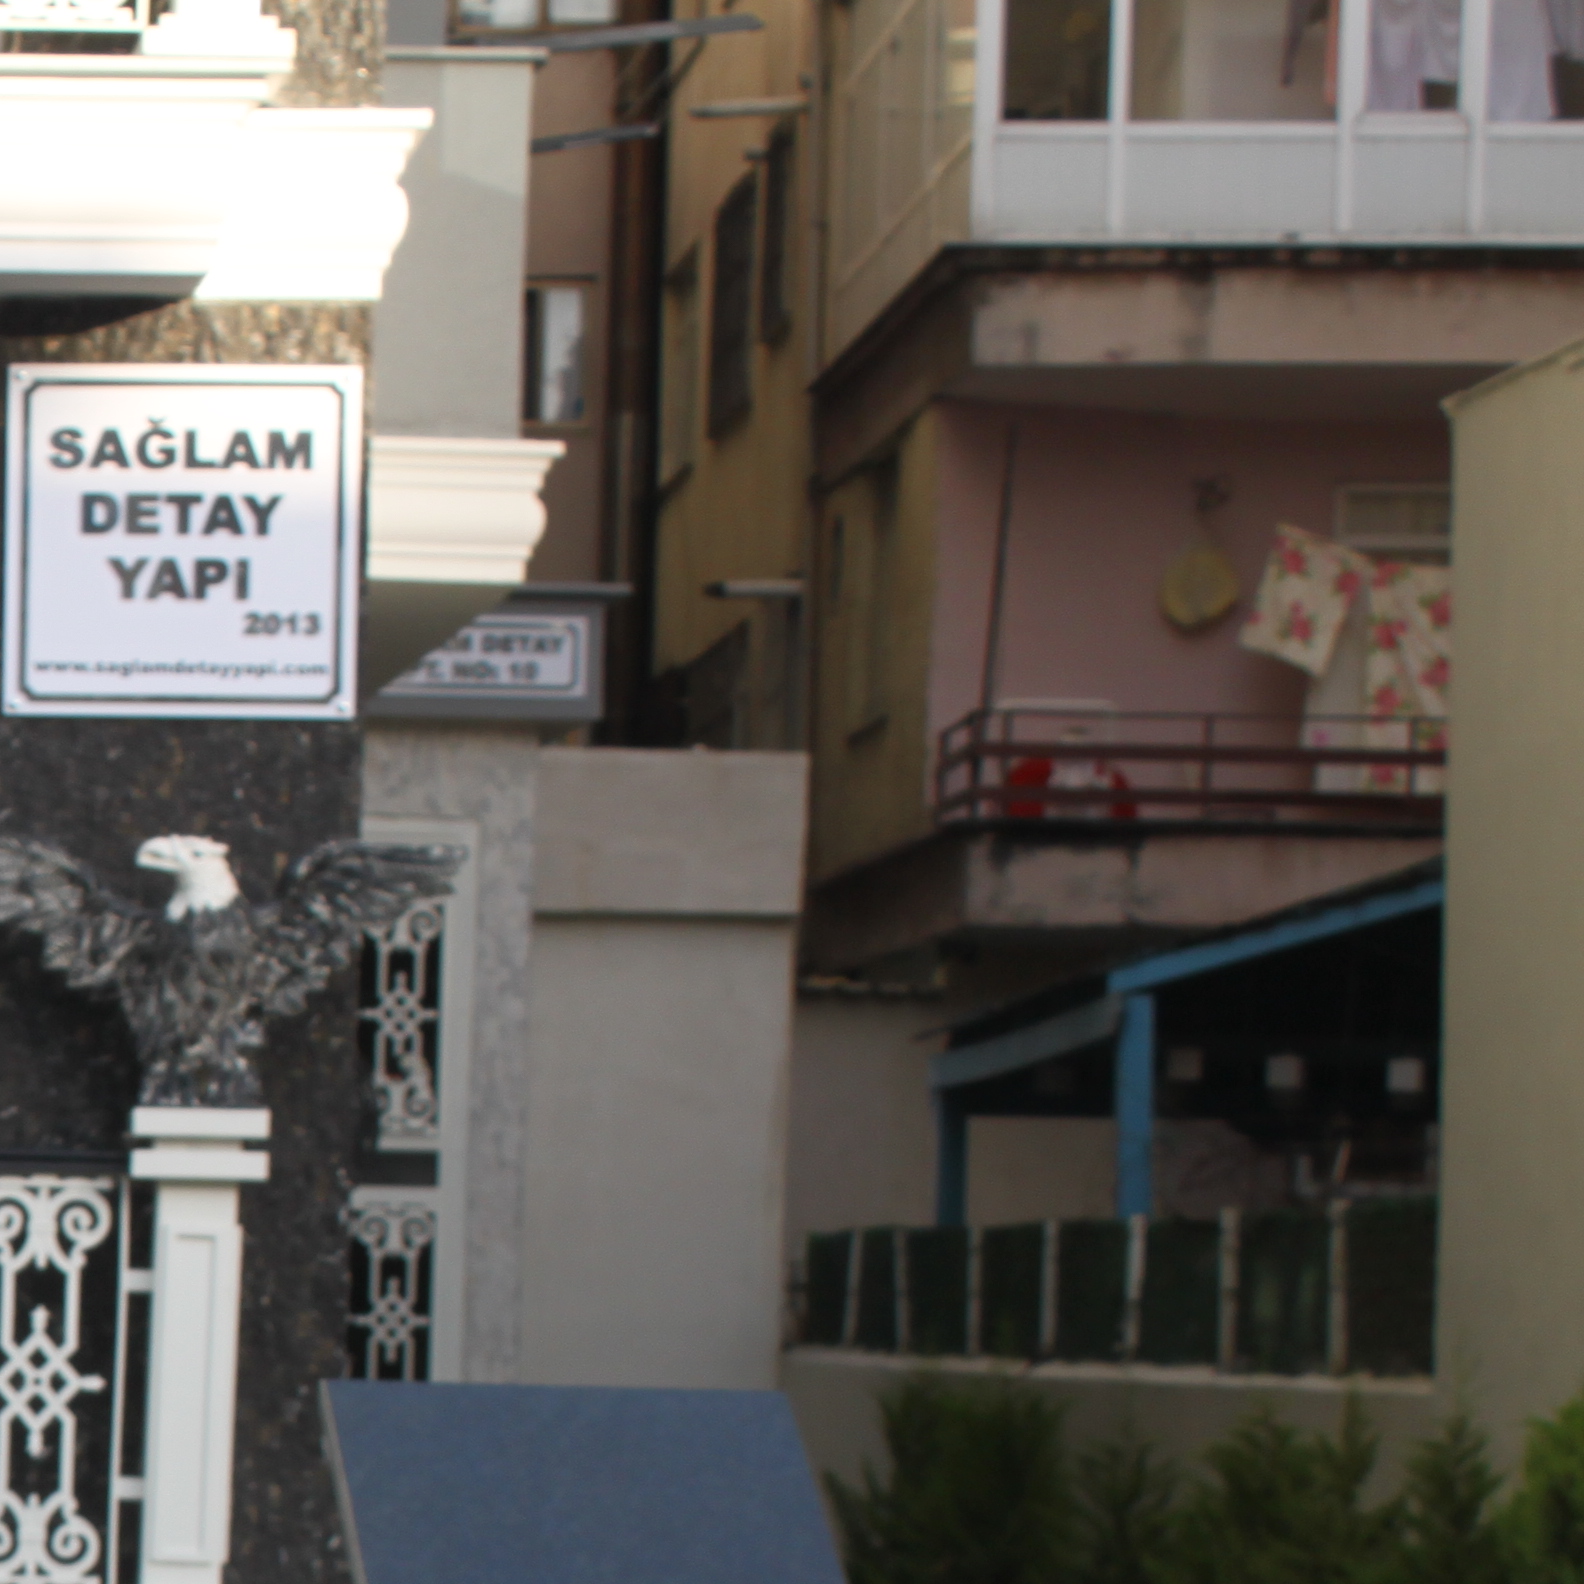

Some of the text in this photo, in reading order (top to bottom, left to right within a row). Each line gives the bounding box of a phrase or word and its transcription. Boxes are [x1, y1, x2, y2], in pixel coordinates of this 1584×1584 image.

[49, 416, 313, 470] SAĞLAM
[80, 492, 282, 536] DETAY
[108, 557, 250, 601] YAPI
[243, 611, 321, 636] 2013
